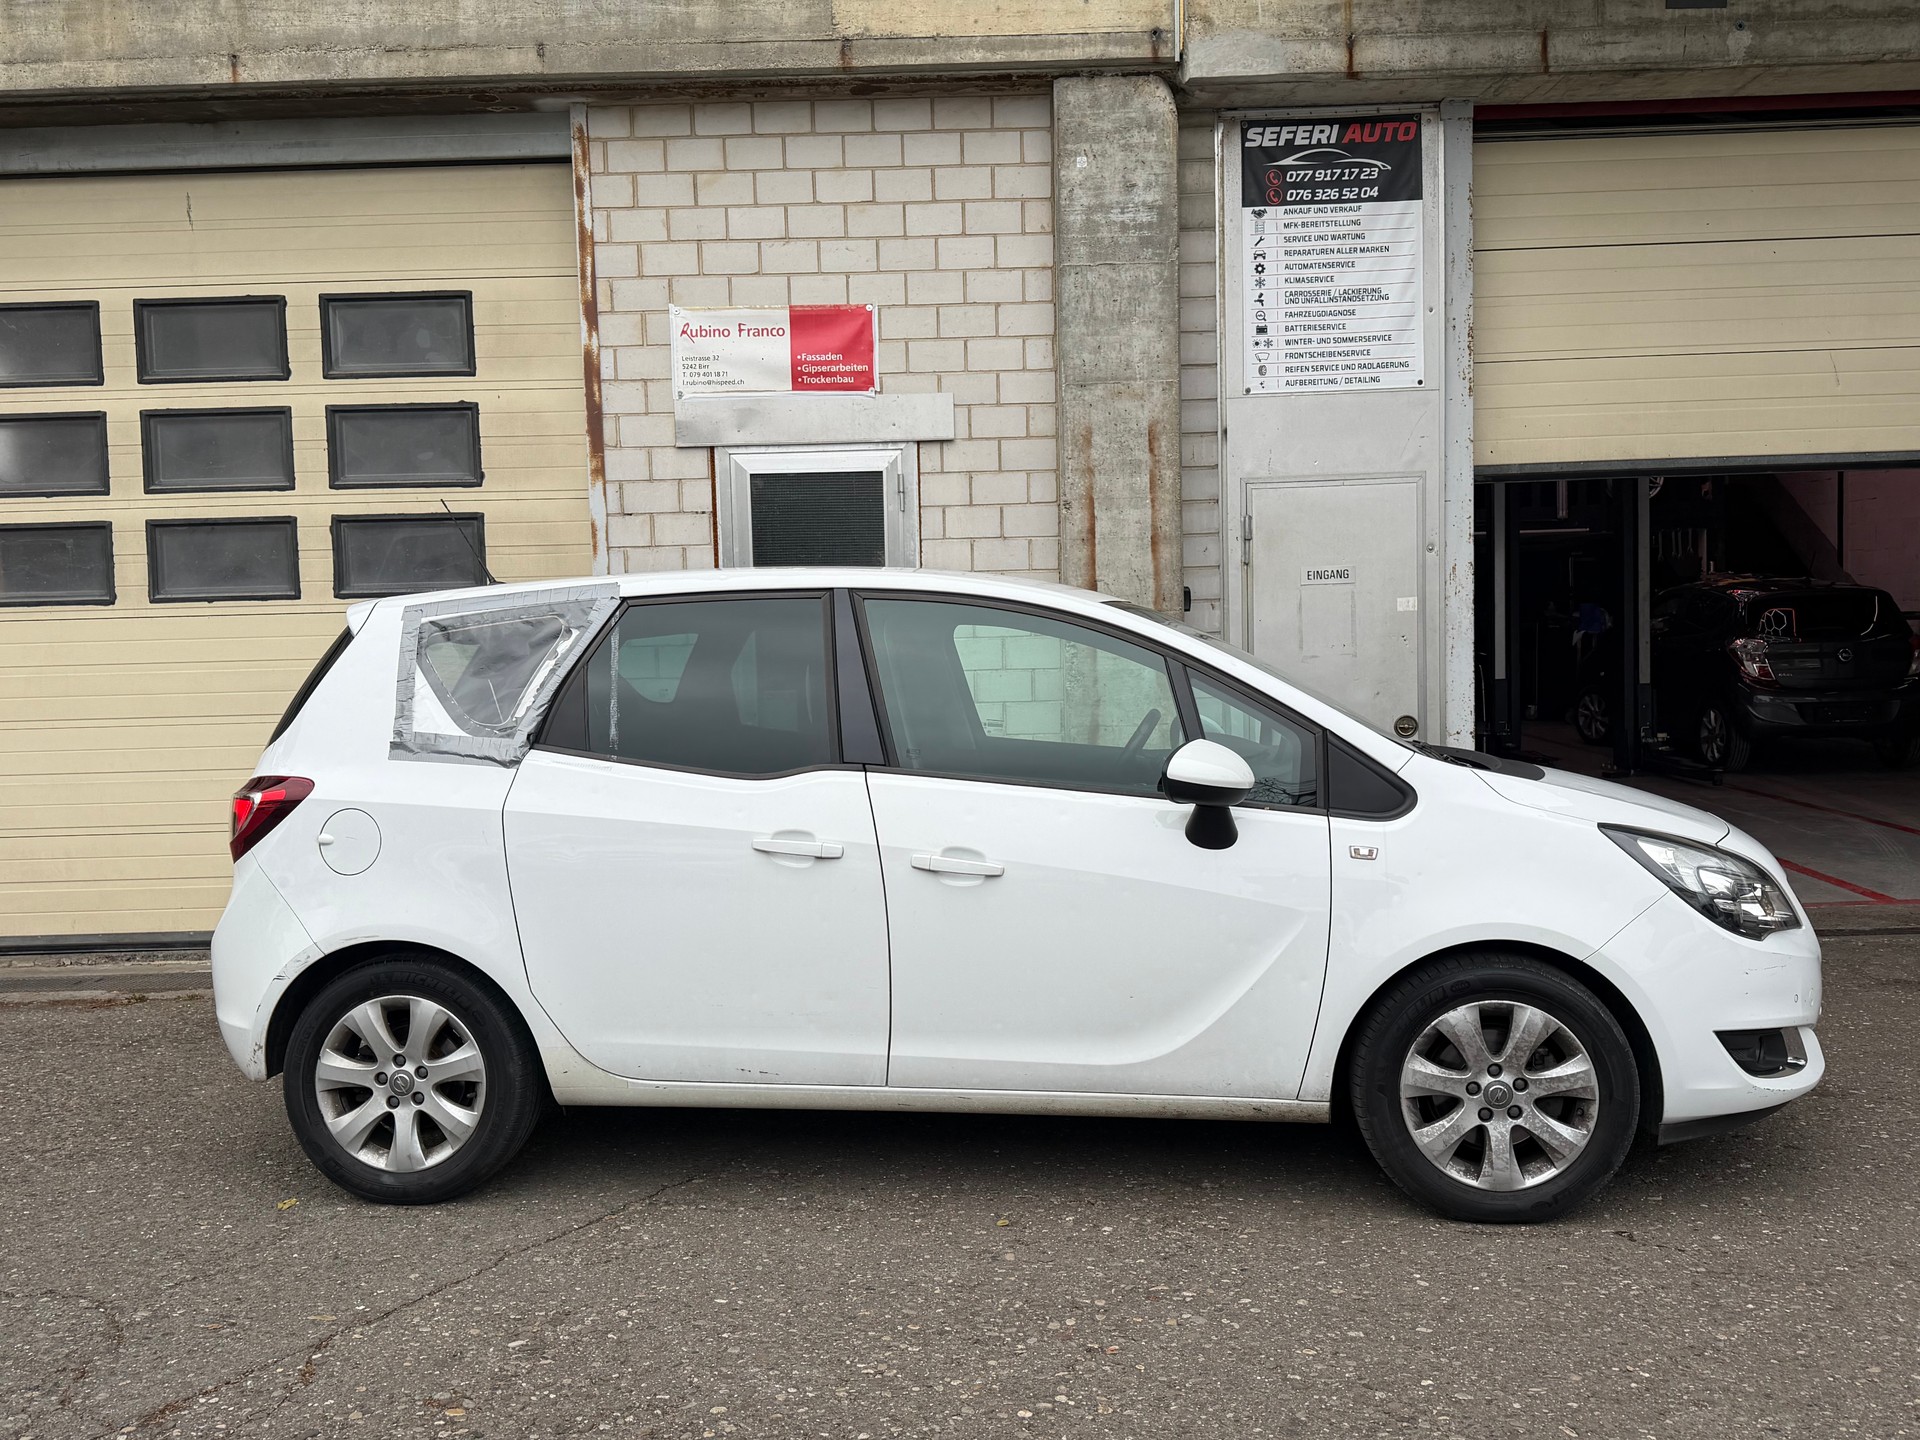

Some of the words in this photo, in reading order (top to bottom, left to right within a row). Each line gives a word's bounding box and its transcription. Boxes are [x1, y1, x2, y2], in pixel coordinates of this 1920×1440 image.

[1245, 124, 1339, 148] SEFERI
[1342, 121, 1417, 144] AUTO
[1286, 170, 1313, 182] 077
[1315, 169, 1341, 181] 917
[1342, 168, 1360, 180] 17
[1360, 168, 1379, 179] 23
[1286, 189, 1312, 201] 076
[1313, 188, 1339, 200] 326
[1341, 187, 1358, 199] 52
[1360, 186, 1379, 198] 04
[1283, 207, 1312, 216] ANKAUF
[1313, 206, 1329, 214] UND
[1329, 205, 1363, 214] VERKAUF
[1283, 219, 1361, 229] MFK-BEREITSTELLUNG
[1283, 235, 1313, 244] SERVICE
[1314, 234, 1329, 243] UND
[1330, 233, 1366, 242] WARTUNG
[1284, 248, 1335, 257] REPARATUREN
[1336, 246, 1358, 255] ALLER
[1359, 245, 1390, 254] MARKEN
[1284, 261, 1356, 271] AUTOMATENSERVICE
[1284, 275, 1335, 284] KLIMASERVICE
[1284, 290, 1332, 298] CARROSSERIE
[1338, 287, 1382, 296] LACKIERUNG
[1284, 297, 1300, 305] UND
[1301, 294, 1390, 304] UNFALLINSTANDSETZUNG
[1284, 309, 1357, 319] FAHRZEUGDIAGNOSE
[679, 322, 731, 344] Rubino
[737, 322, 786, 338] Franco
[1284, 323, 1347, 332] BATTERIESERVICE
[1284, 338, 1316, 346] WINTER-
[1316, 337, 1332, 345] UND
[1332, 334, 1392, 344] SOMMERSERVICE
[801, 353, 843, 362] Fassaden
[1285, 349, 1371, 360] FRONTSCHEIBENSERVICE
[802, 364, 869, 373] Gipserarbeiten
[1285, 365, 1310, 374] REIFEN
[1311, 364, 1339, 372] SERVICE
[1340, 363, 1356, 371] UND
[1357, 361, 1409, 370] RADLAGERUNG
[802, 376, 854, 384] Trockenbau
[1285, 377, 1338, 387] AUFBEREITUNG
[1344, 376, 1381, 385] DETAILING
[1306, 569, 1350, 580] EINGANG
[391, 971, 470, 1013] MICHELIN
